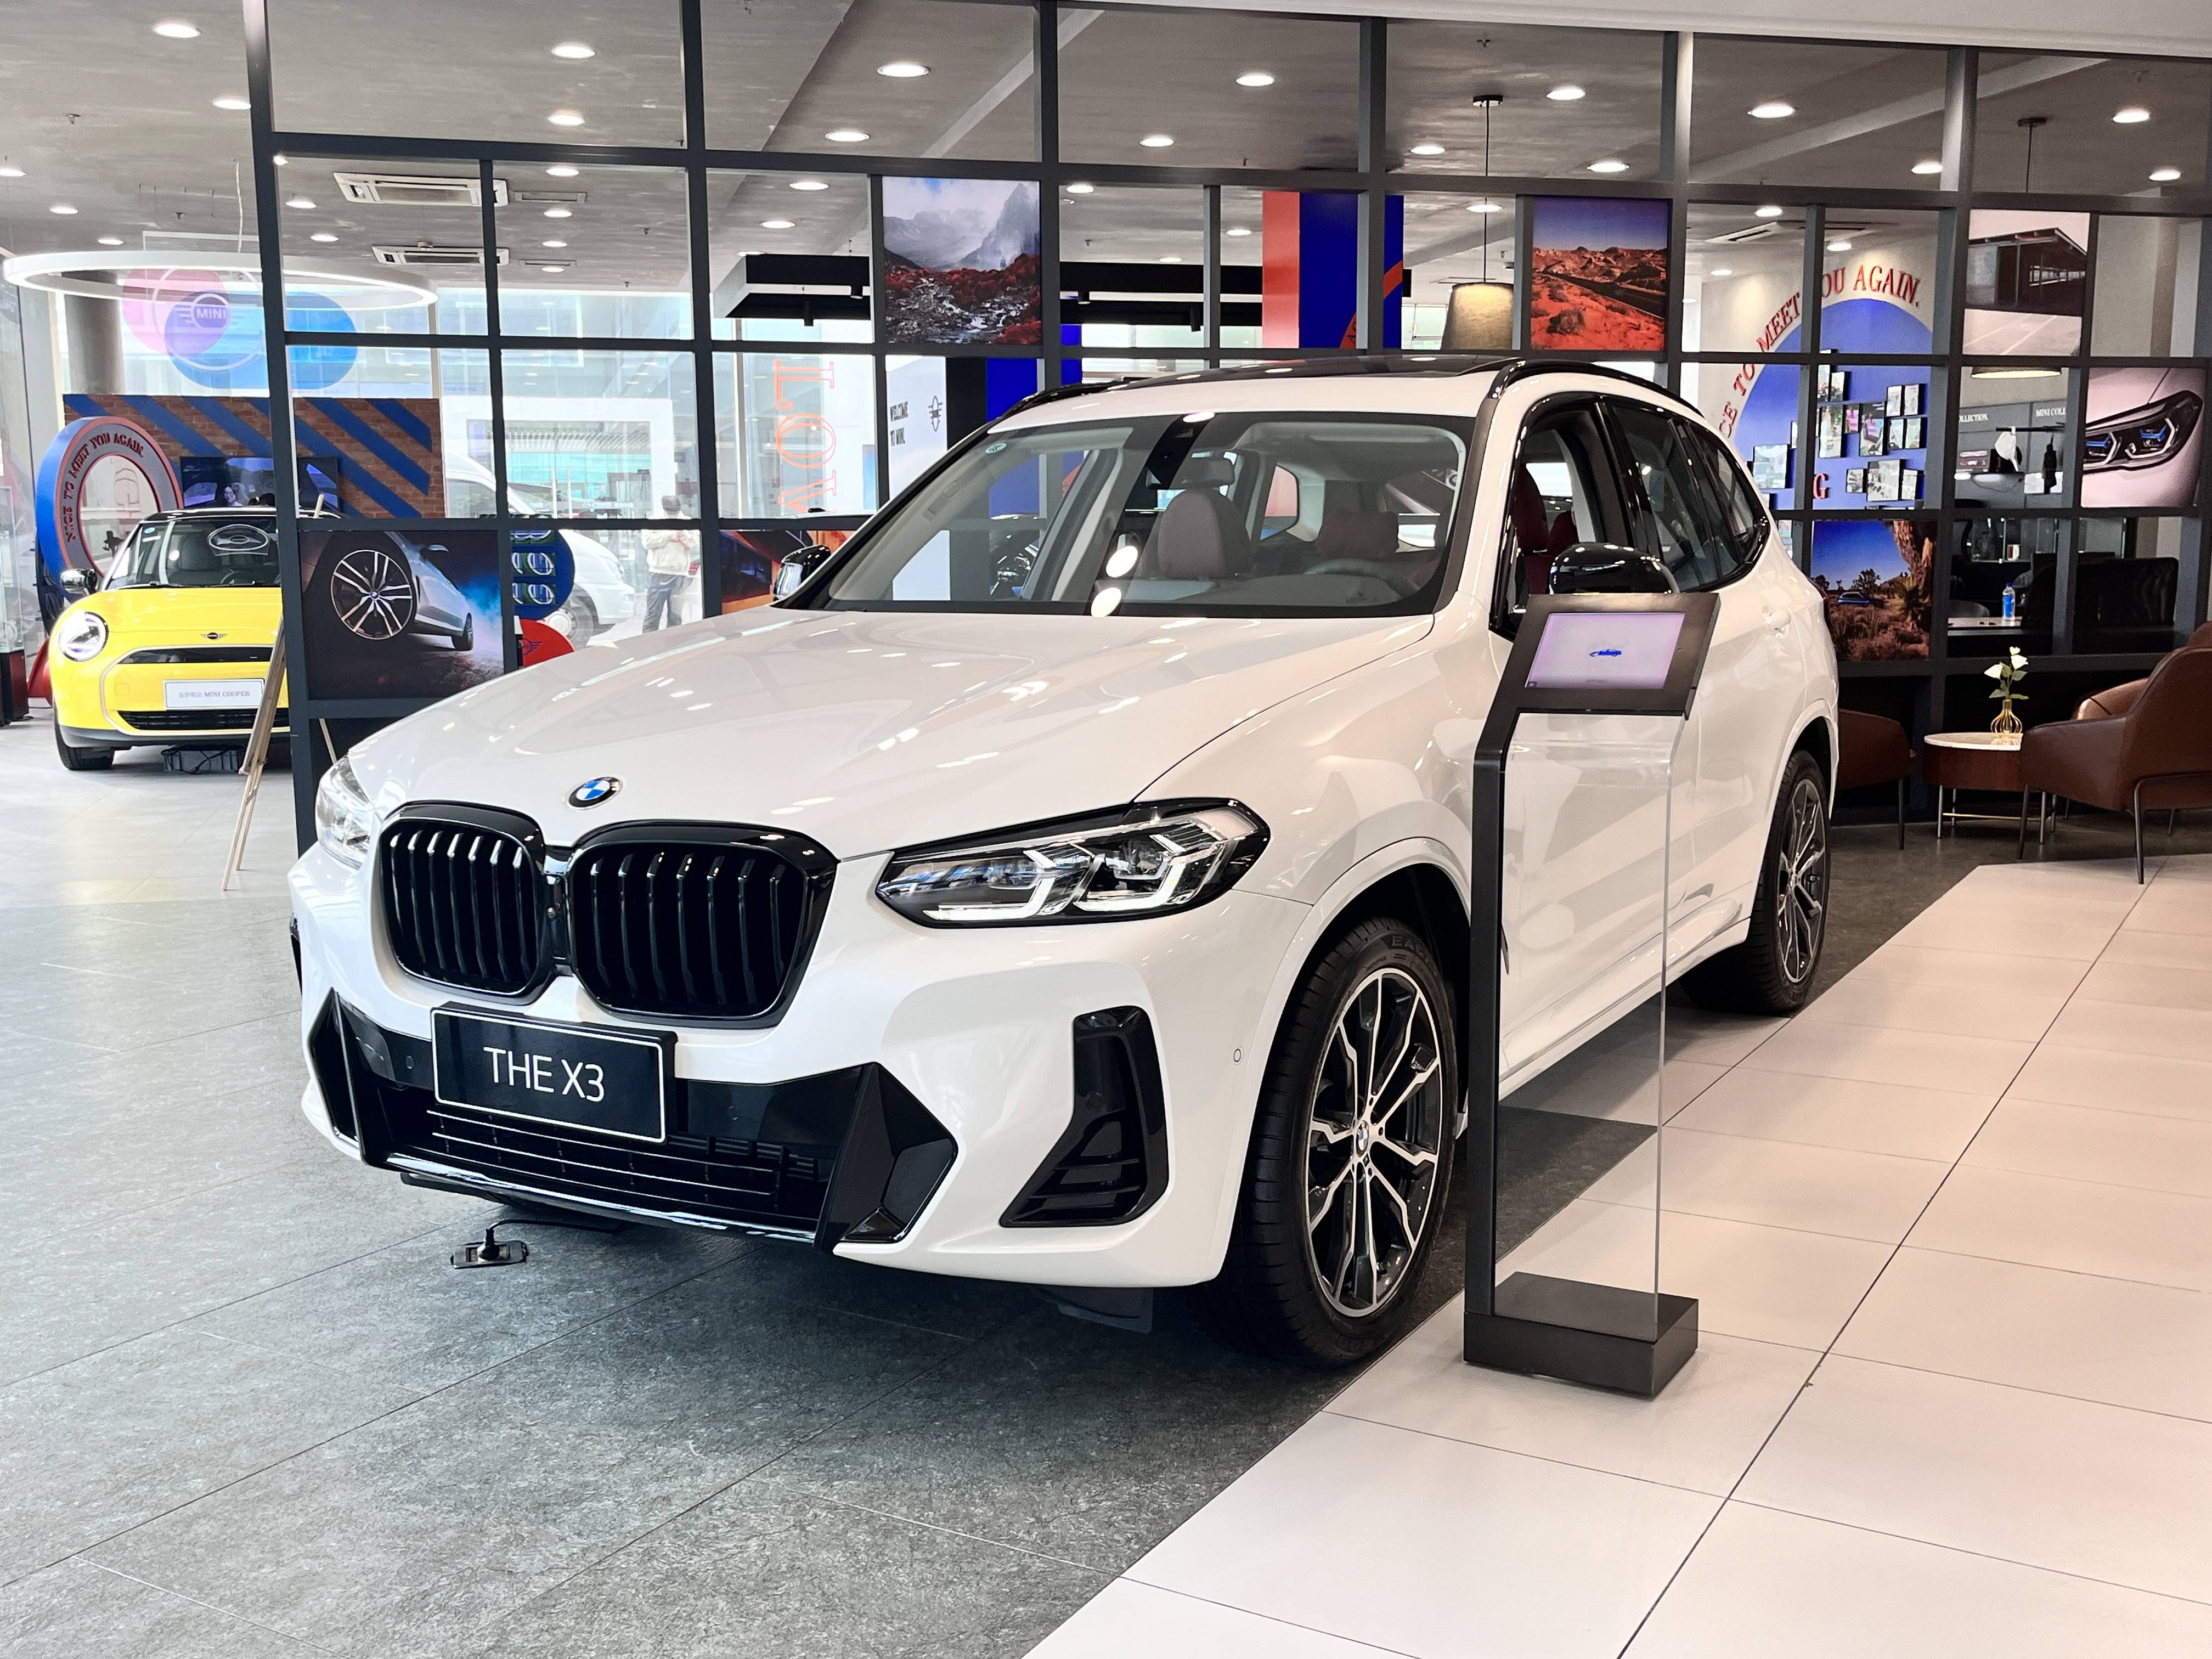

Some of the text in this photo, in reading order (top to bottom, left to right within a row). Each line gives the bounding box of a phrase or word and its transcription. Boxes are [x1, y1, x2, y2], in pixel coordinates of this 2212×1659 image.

[196, 308, 226, 319] MINI
[1733, 364, 1754, 396] TO
[1756, 292, 1801, 352] MEET
[1822, 268, 1846, 298] OU
[1853, 266, 1922, 307] AGAIN.
[89, 433, 111, 449] YOU
[69, 443, 90, 478] MEET
[64, 480, 75, 500] TO
[483, 1047, 605, 1102] THE X3
